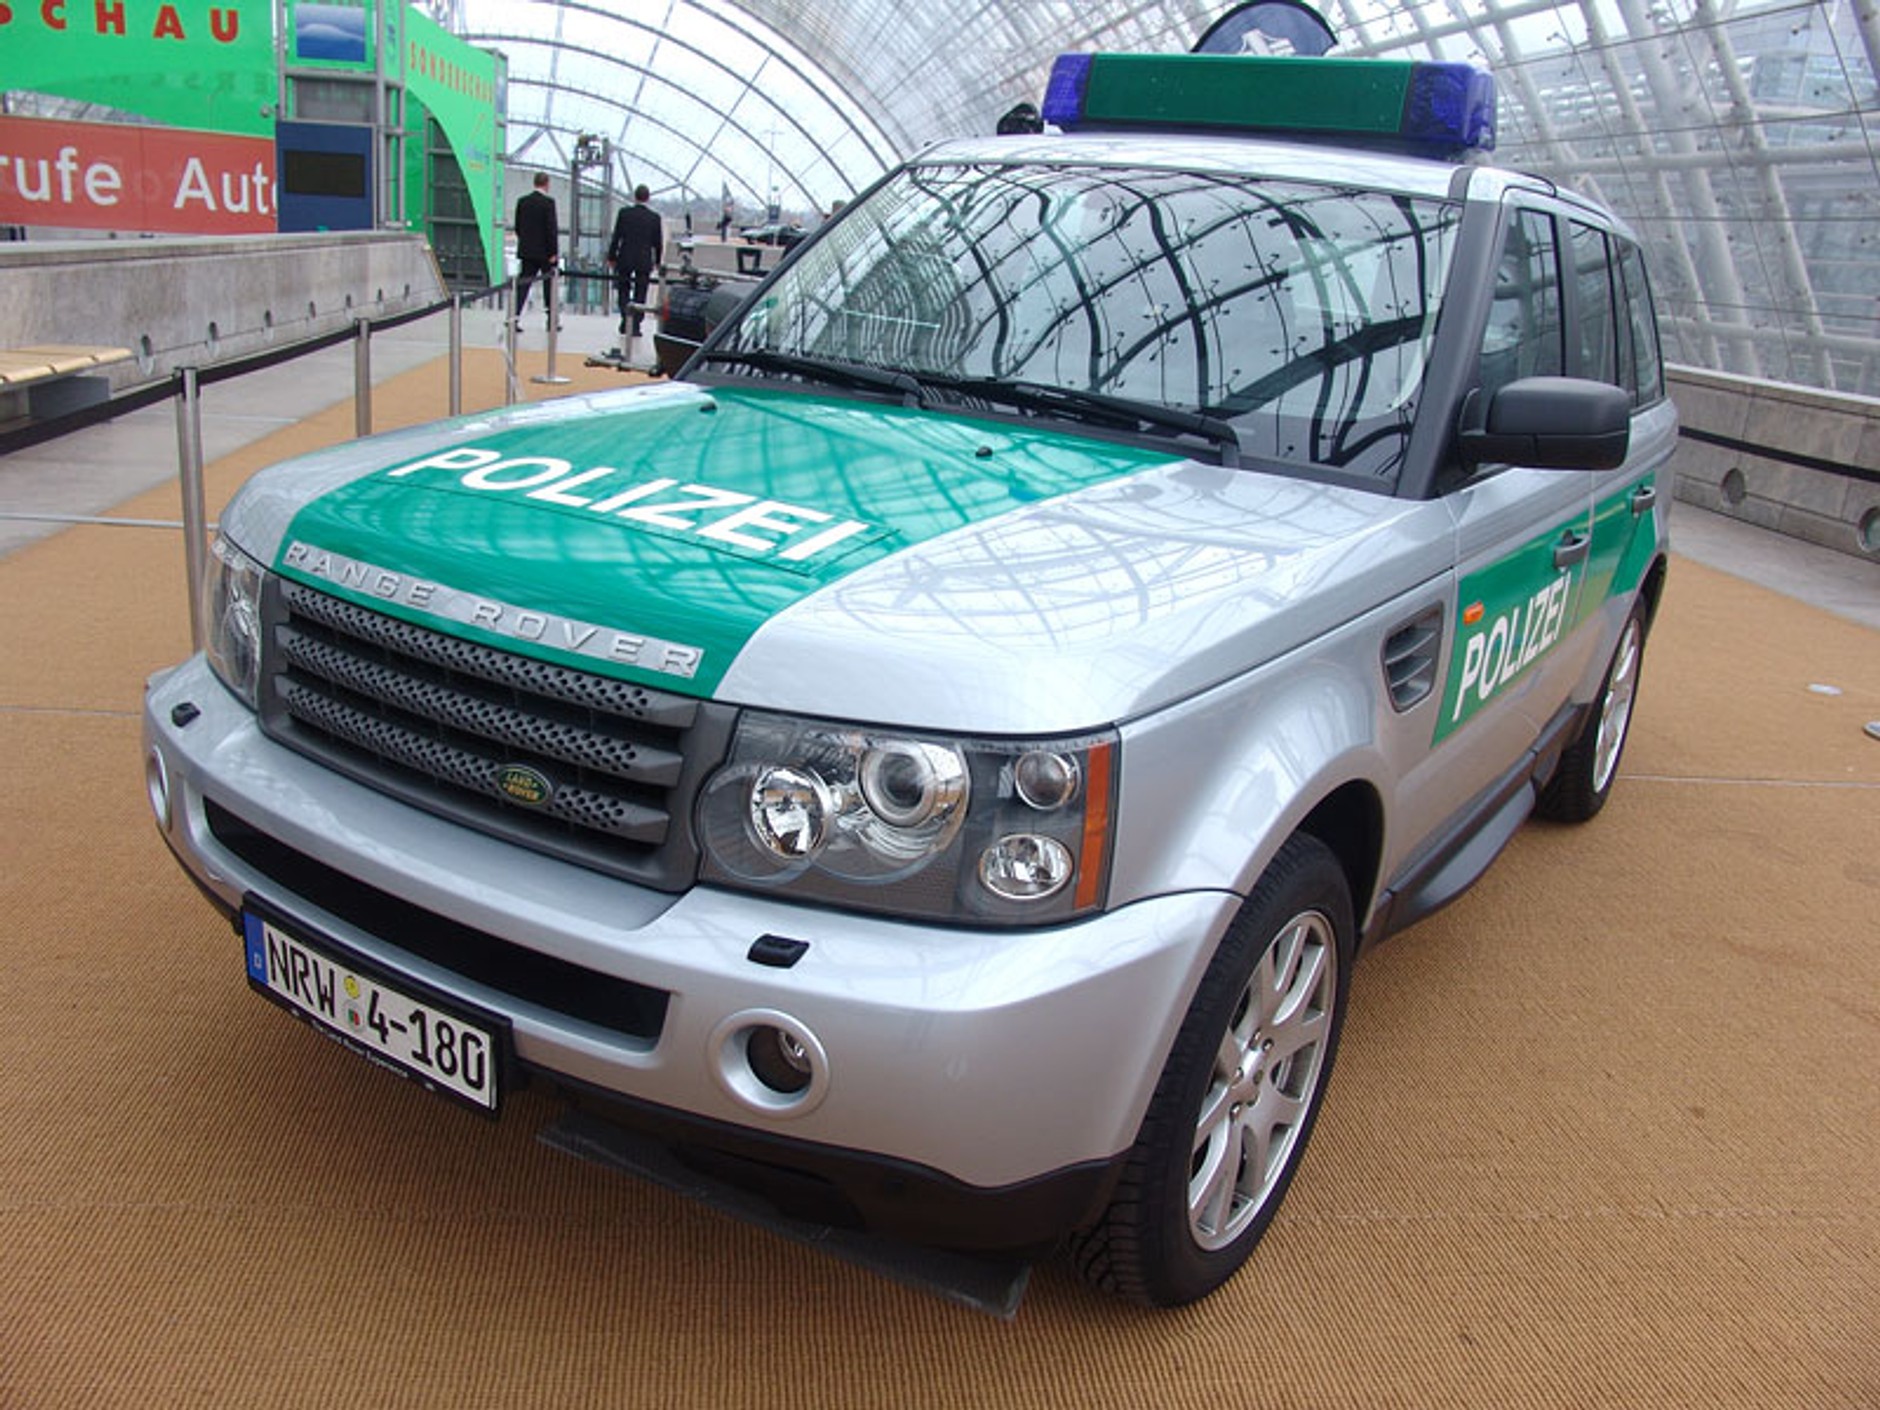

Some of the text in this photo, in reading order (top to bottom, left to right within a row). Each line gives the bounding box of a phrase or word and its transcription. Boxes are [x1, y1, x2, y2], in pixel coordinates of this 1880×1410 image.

[388, 448, 869, 561] POLIZEI
[284, 540, 705, 679] RANGE ROVER
[1452, 572, 1571, 721] POLIZEI
[267, 932, 336, 1018] NRW
[367, 989, 485, 1091] 4-180
